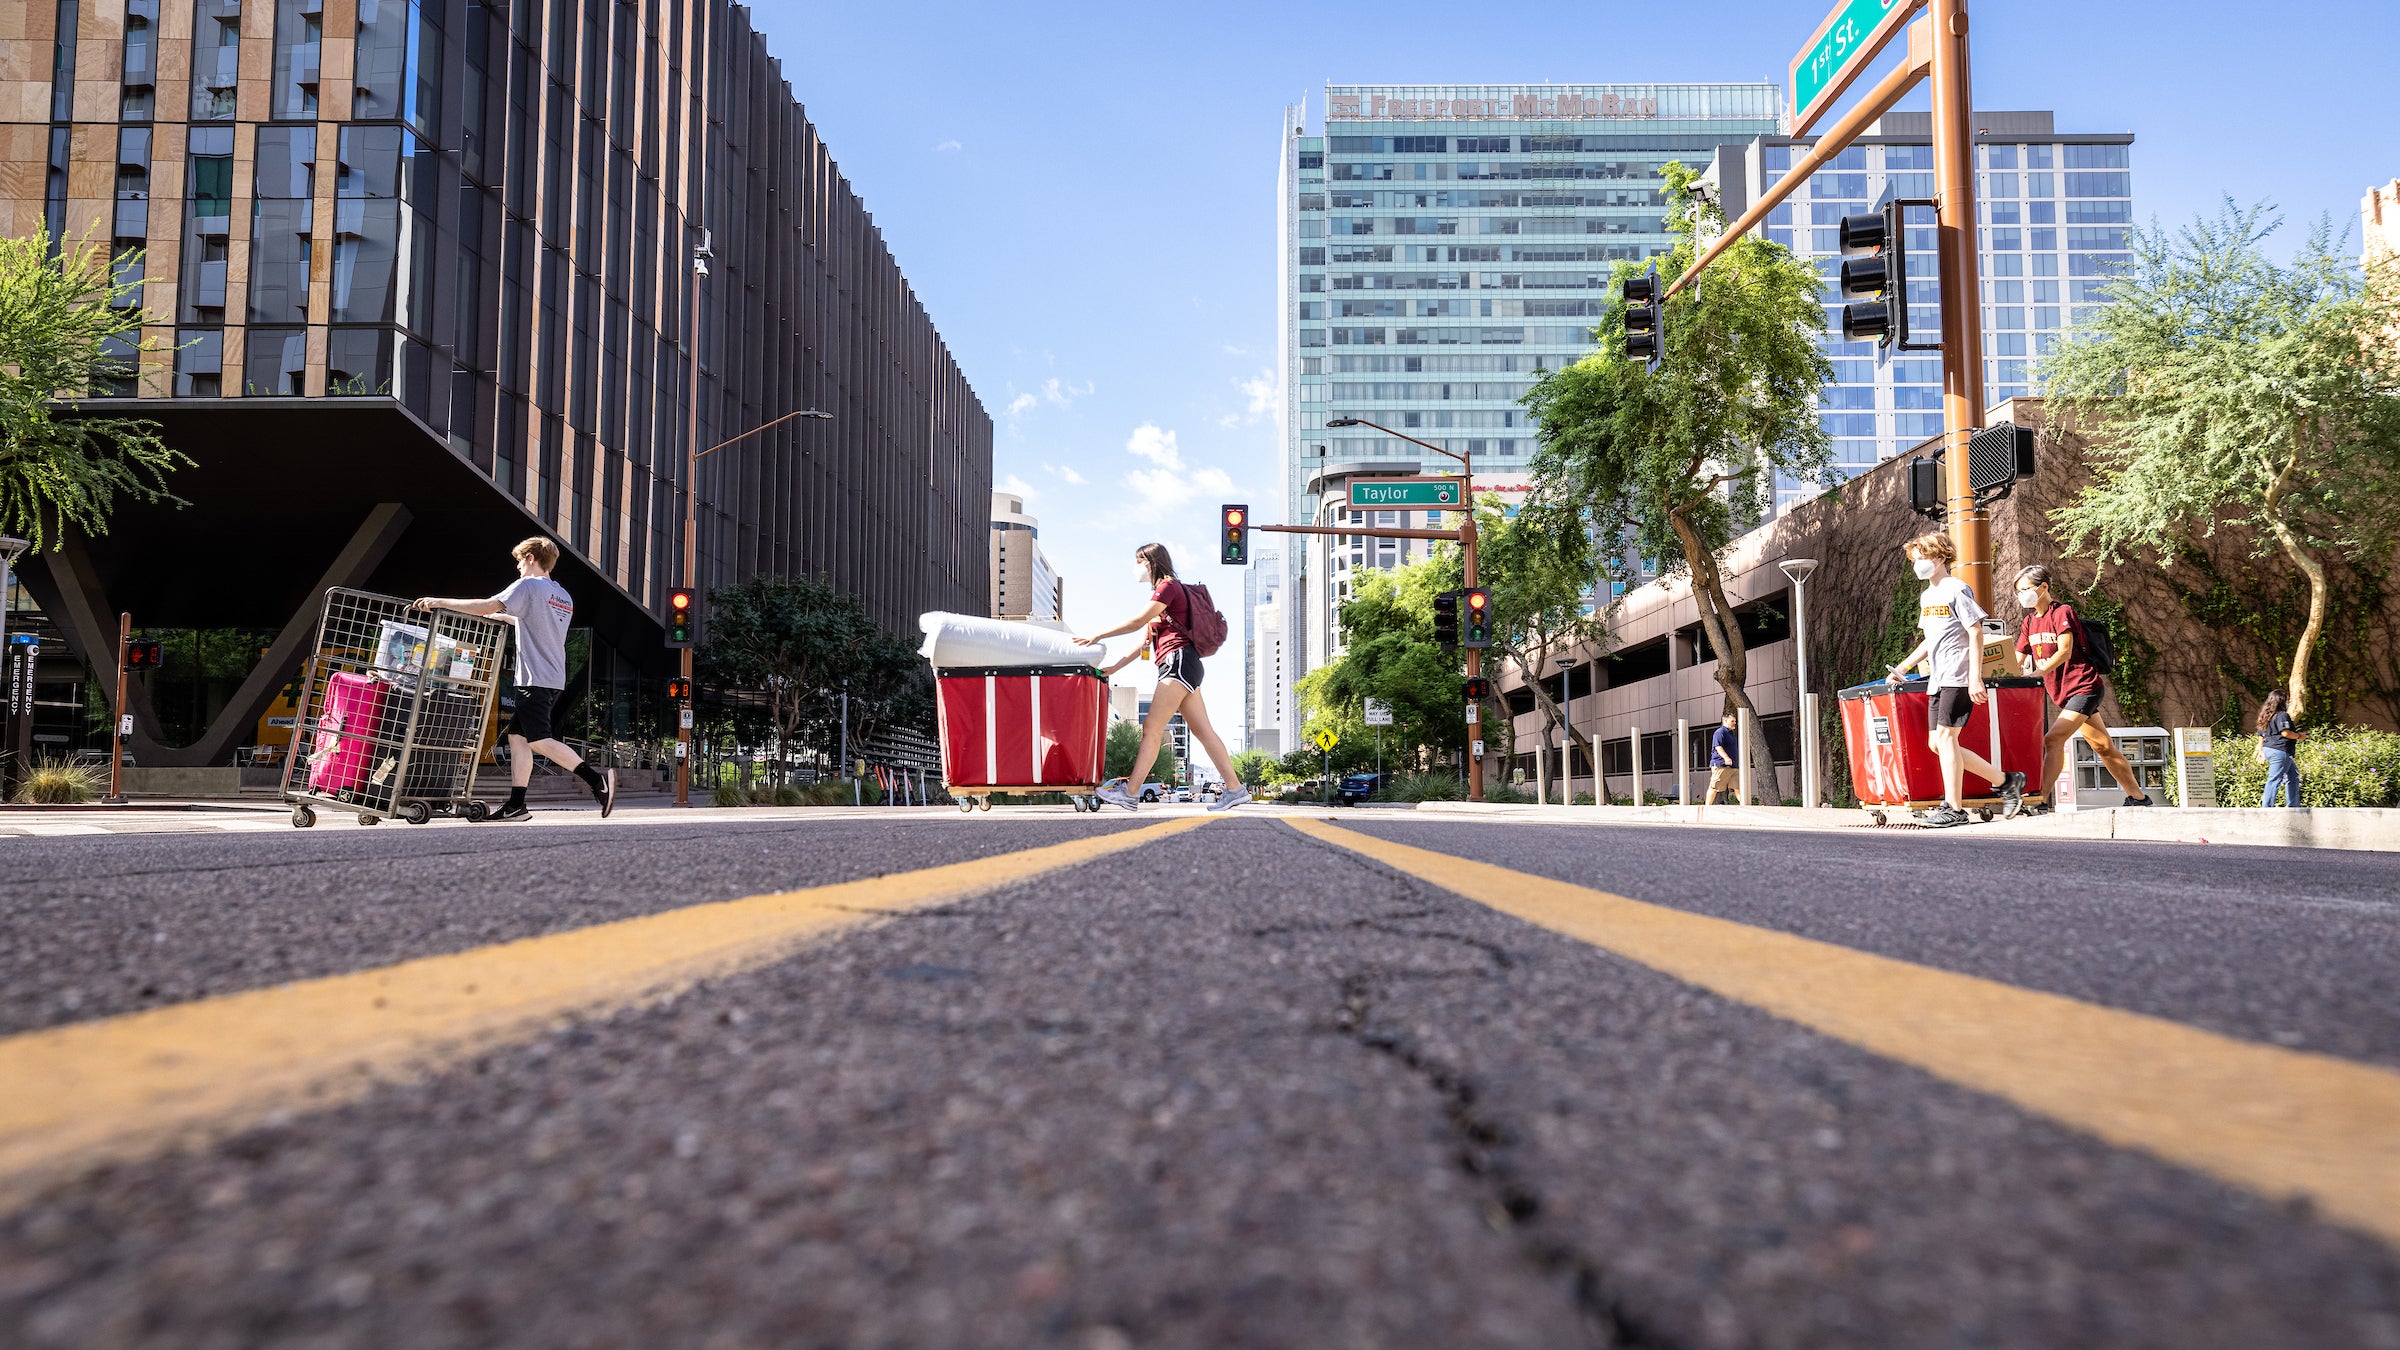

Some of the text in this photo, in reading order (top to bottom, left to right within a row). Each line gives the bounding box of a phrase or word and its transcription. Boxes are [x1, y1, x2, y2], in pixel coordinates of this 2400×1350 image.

[1811, 16, 1860, 84] 1st St.
[1362, 487, 1408, 502] Taylor
[11, 655, 21, 715] EMERGENCY
[25, 656, 35, 716] EMERGENCY
